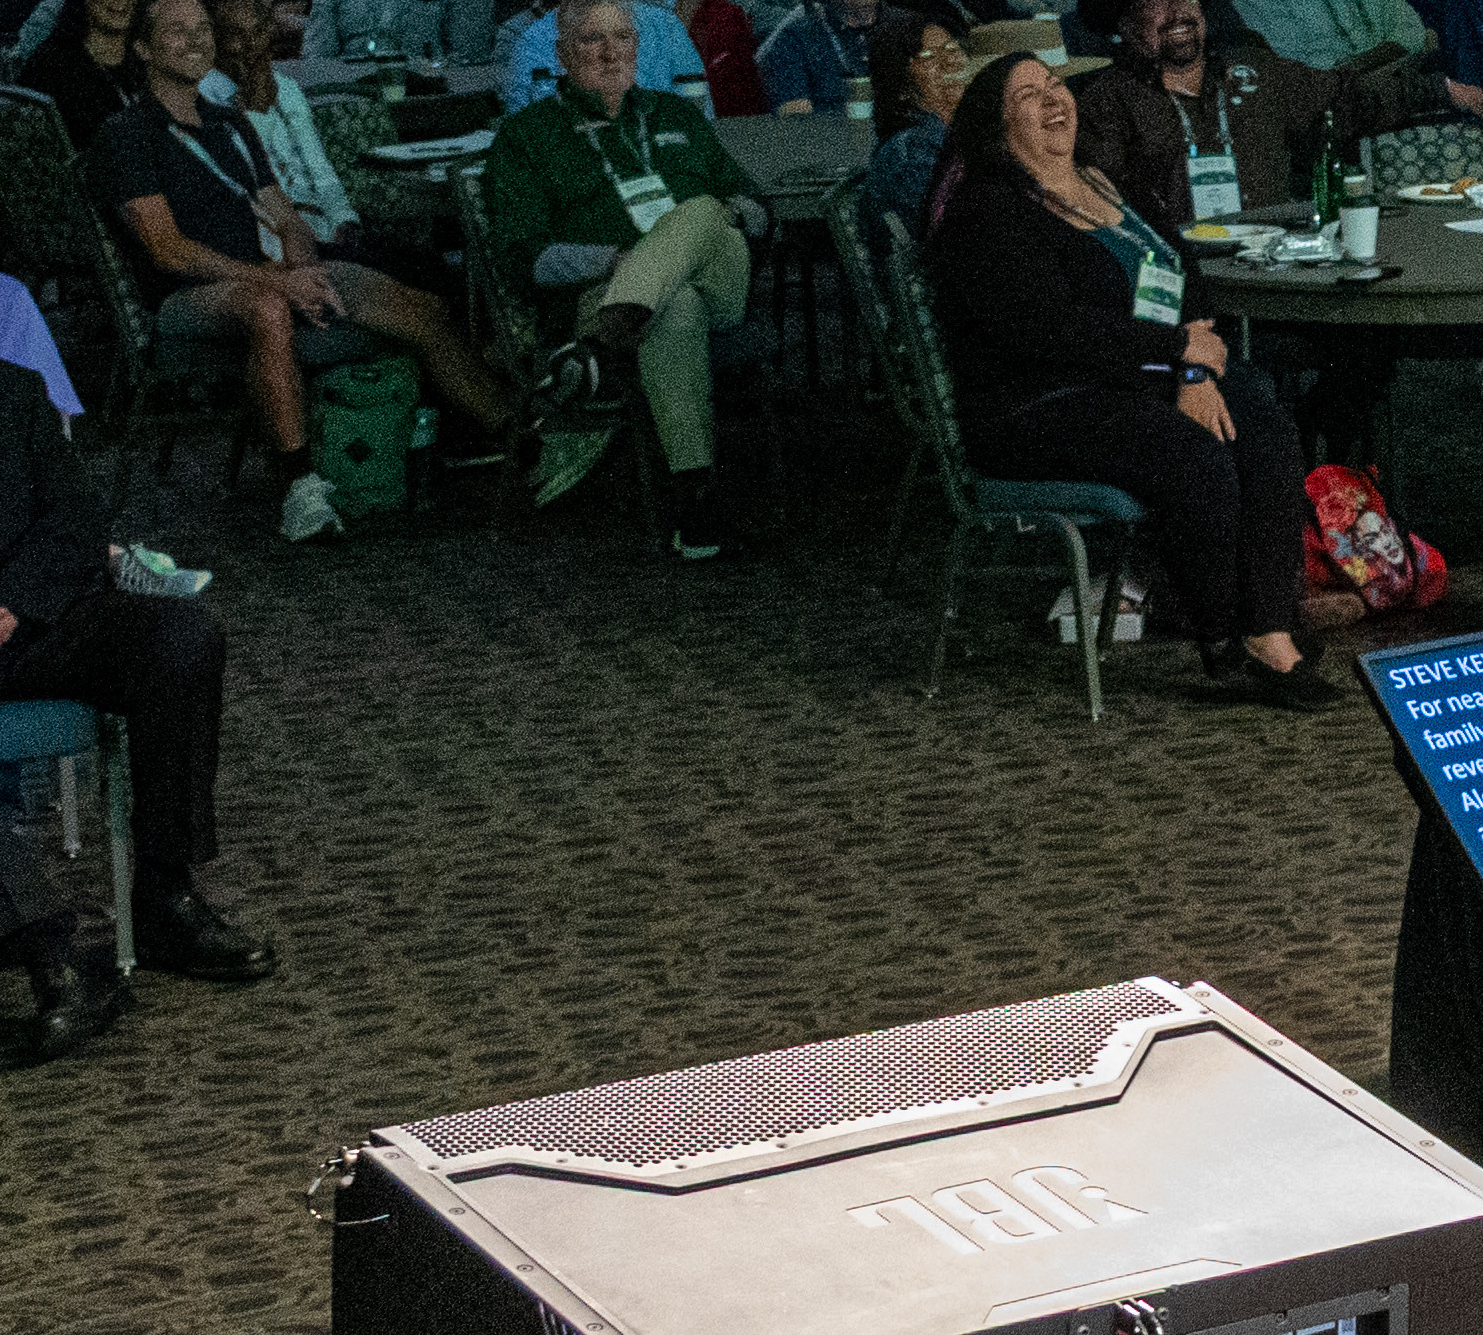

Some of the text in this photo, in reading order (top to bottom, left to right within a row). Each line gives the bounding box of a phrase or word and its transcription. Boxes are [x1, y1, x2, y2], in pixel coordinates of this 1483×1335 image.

[1389, 660, 1457, 689] STEVE
[1406, 699, 1442, 719] For
[846, 1165, 1149, 1256] JBL
